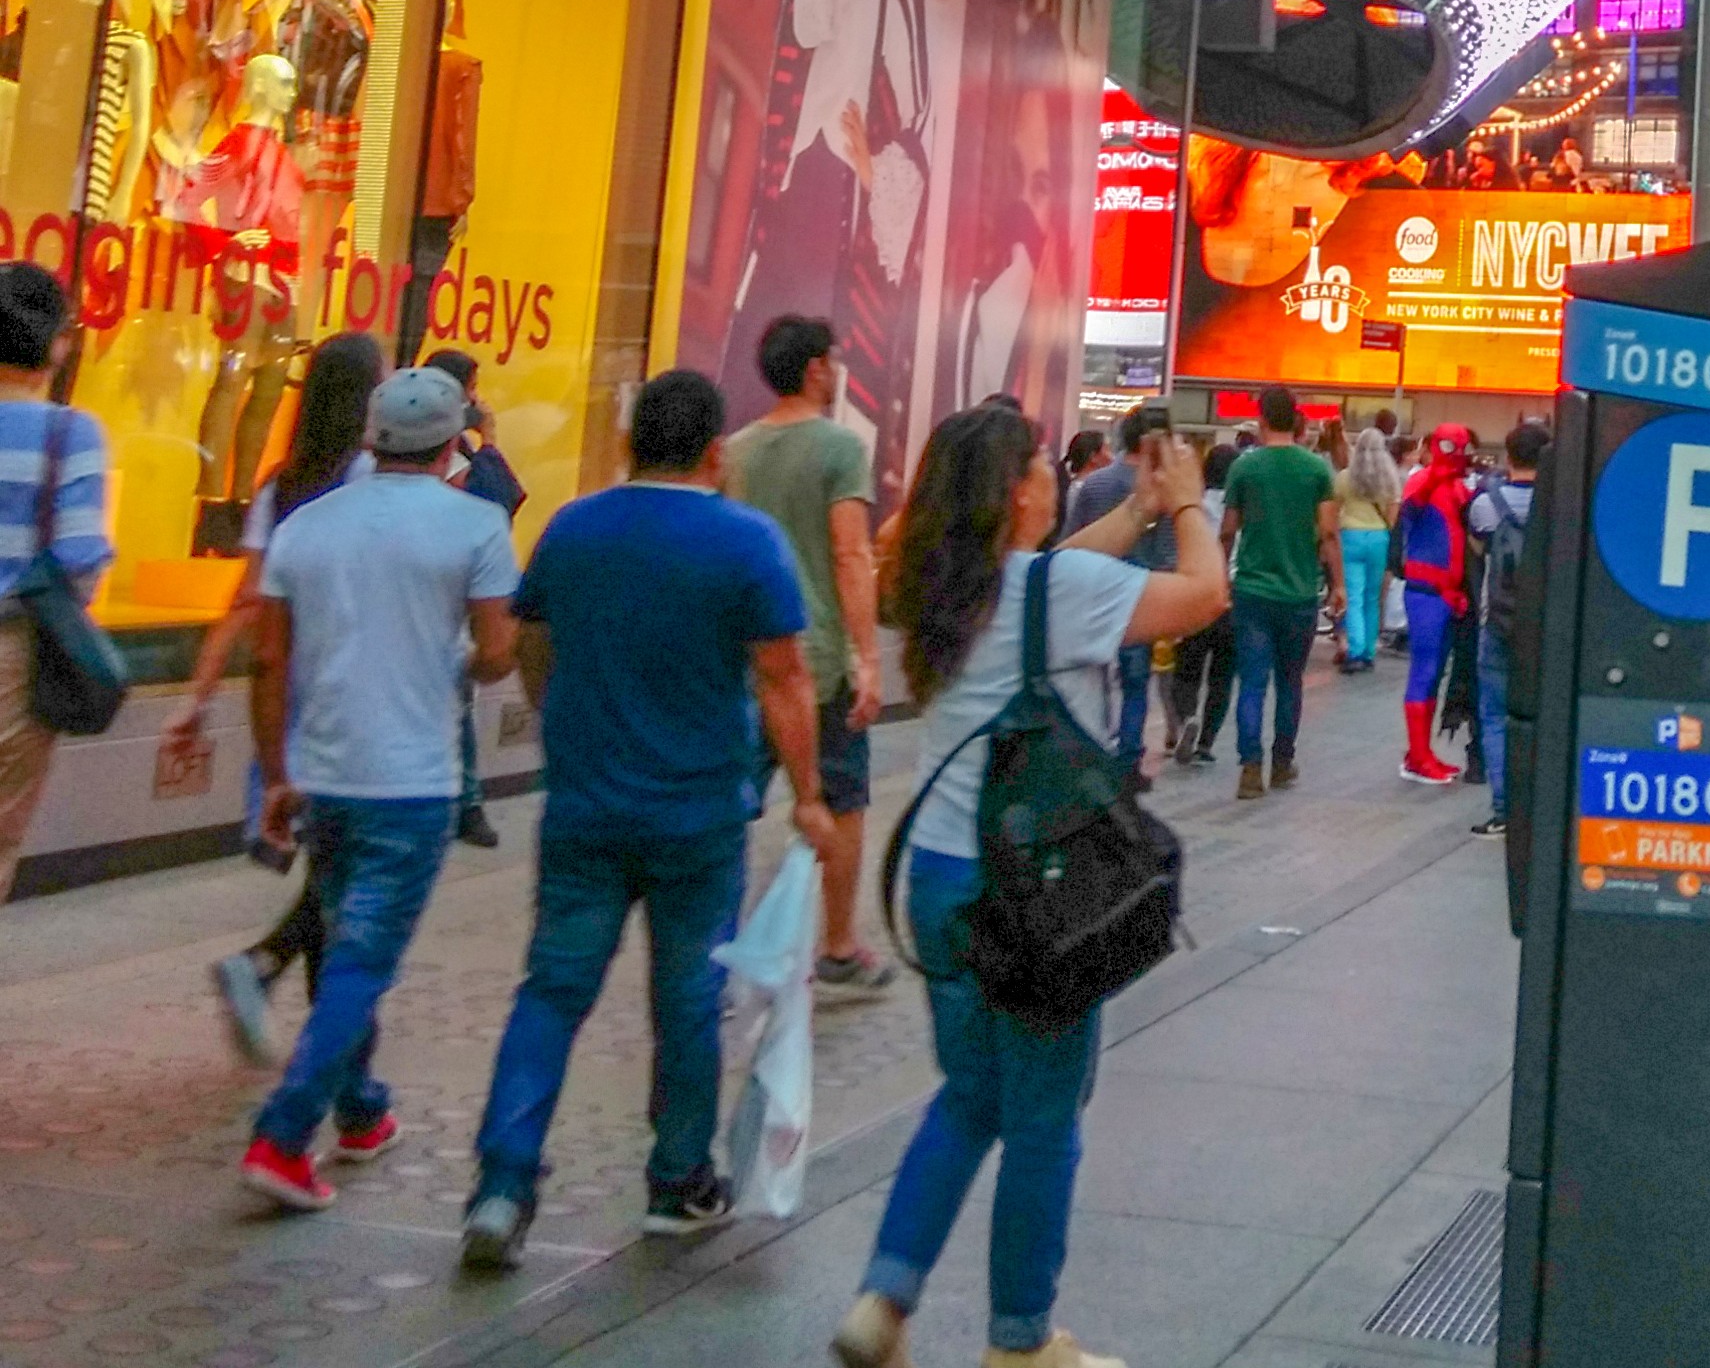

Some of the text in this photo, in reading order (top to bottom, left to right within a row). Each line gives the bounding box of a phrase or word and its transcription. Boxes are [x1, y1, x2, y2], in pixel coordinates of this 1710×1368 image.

[1400, 227, 1437, 249] food
[323, 224, 412, 332] for
[428, 247, 554, 366] days
[1299, 284, 1351, 300] YEARS
[1386, 303, 1419, 317] NEW
[1422, 305, 1458, 319] YORK
[1462, 305, 1492, 320] CITY
[1498, 307, 1534, 321] WINE
[1539, 309, 1549, 322] &
